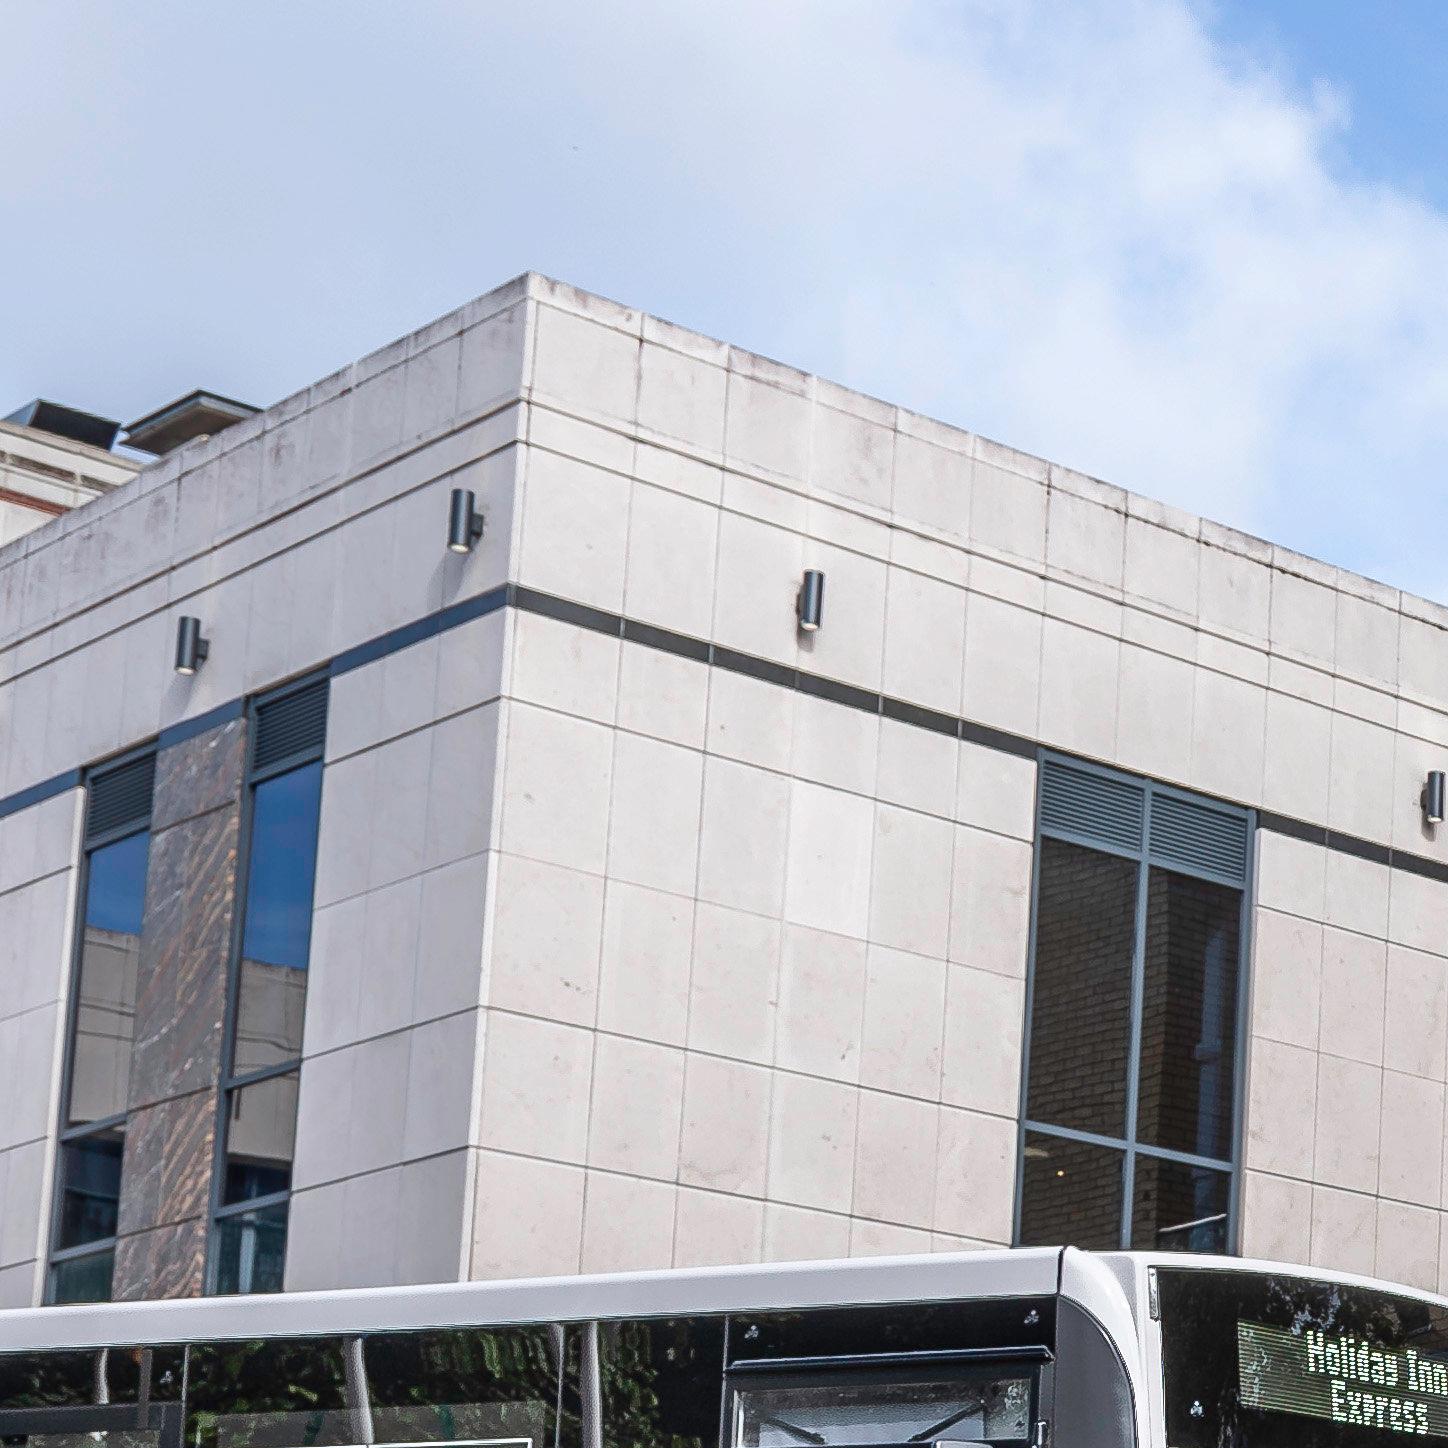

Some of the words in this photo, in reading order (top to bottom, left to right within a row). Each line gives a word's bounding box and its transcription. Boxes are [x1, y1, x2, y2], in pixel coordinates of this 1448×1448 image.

[1306, 1330, 1399, 1387] Holiday
[1405, 1349, 1448, 1396] Inn
[1330, 1379, 1430, 1435] Express
